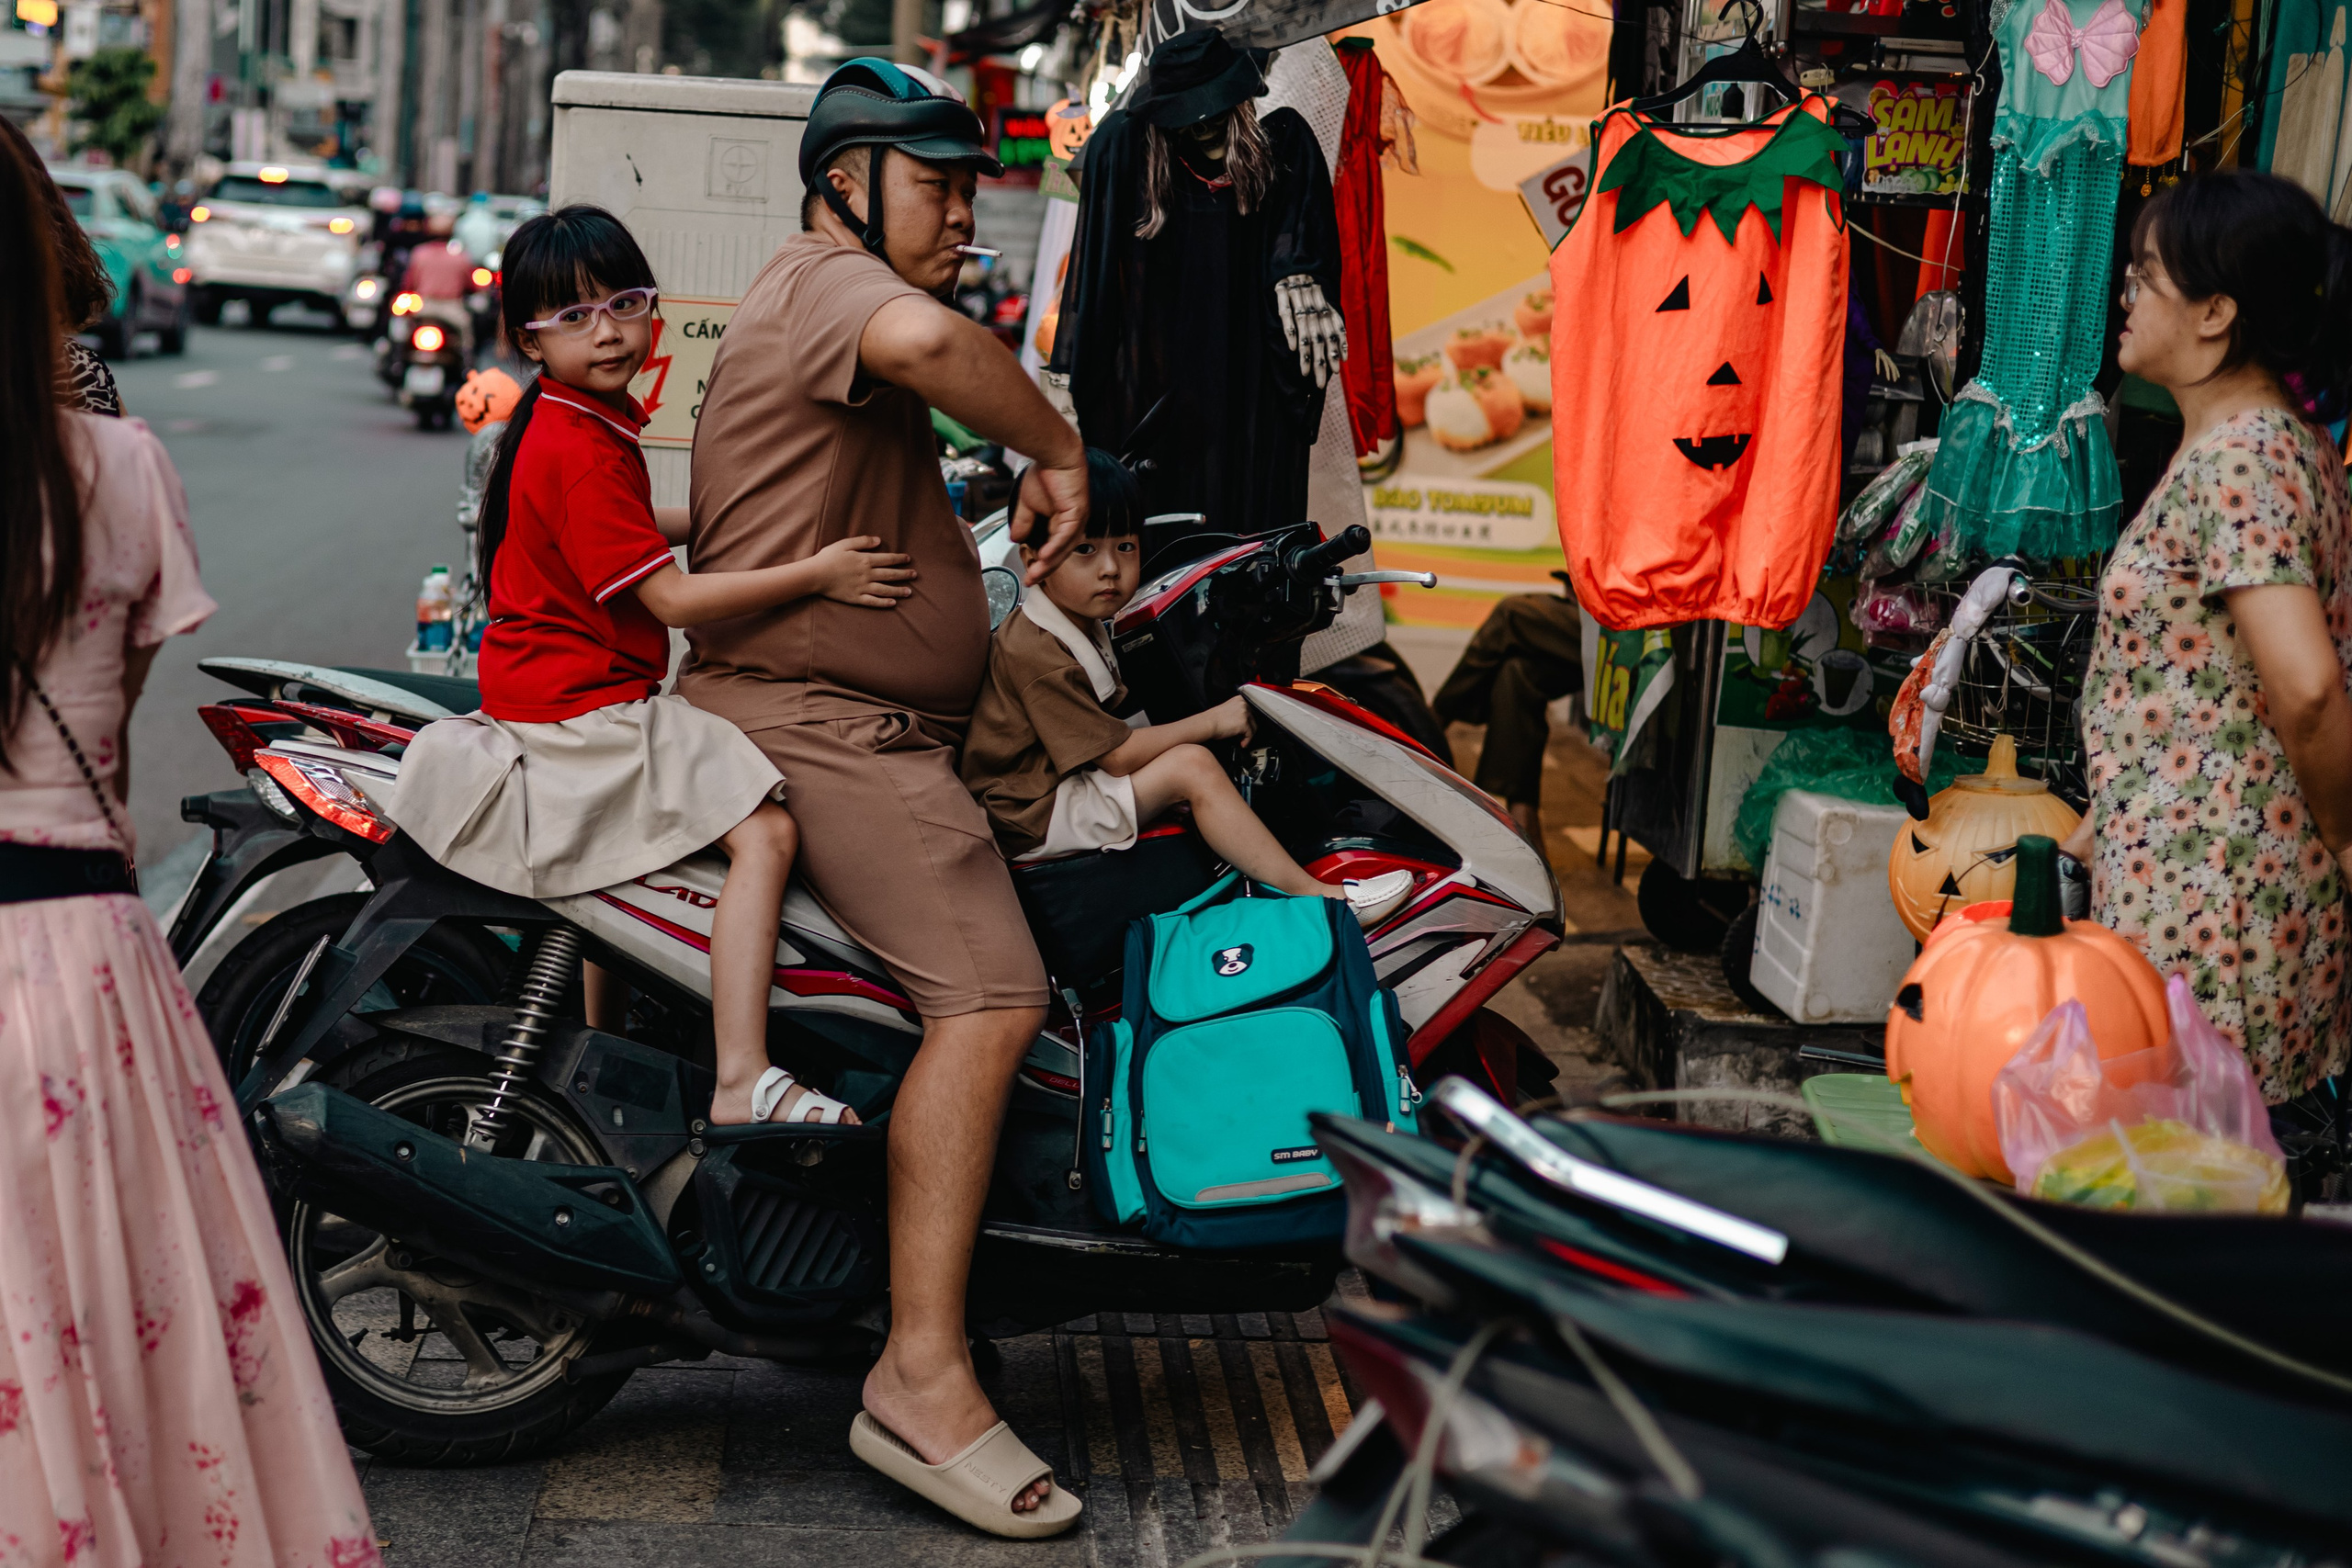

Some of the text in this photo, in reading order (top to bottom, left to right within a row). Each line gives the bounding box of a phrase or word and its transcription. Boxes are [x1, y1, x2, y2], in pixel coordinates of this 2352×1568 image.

[1873, 91, 1956, 132] SÂM
[1867, 131, 1964, 172] LẠNH
[683, 318, 727, 339] CẤM
[1292, 1149, 1318, 1158] BABY
